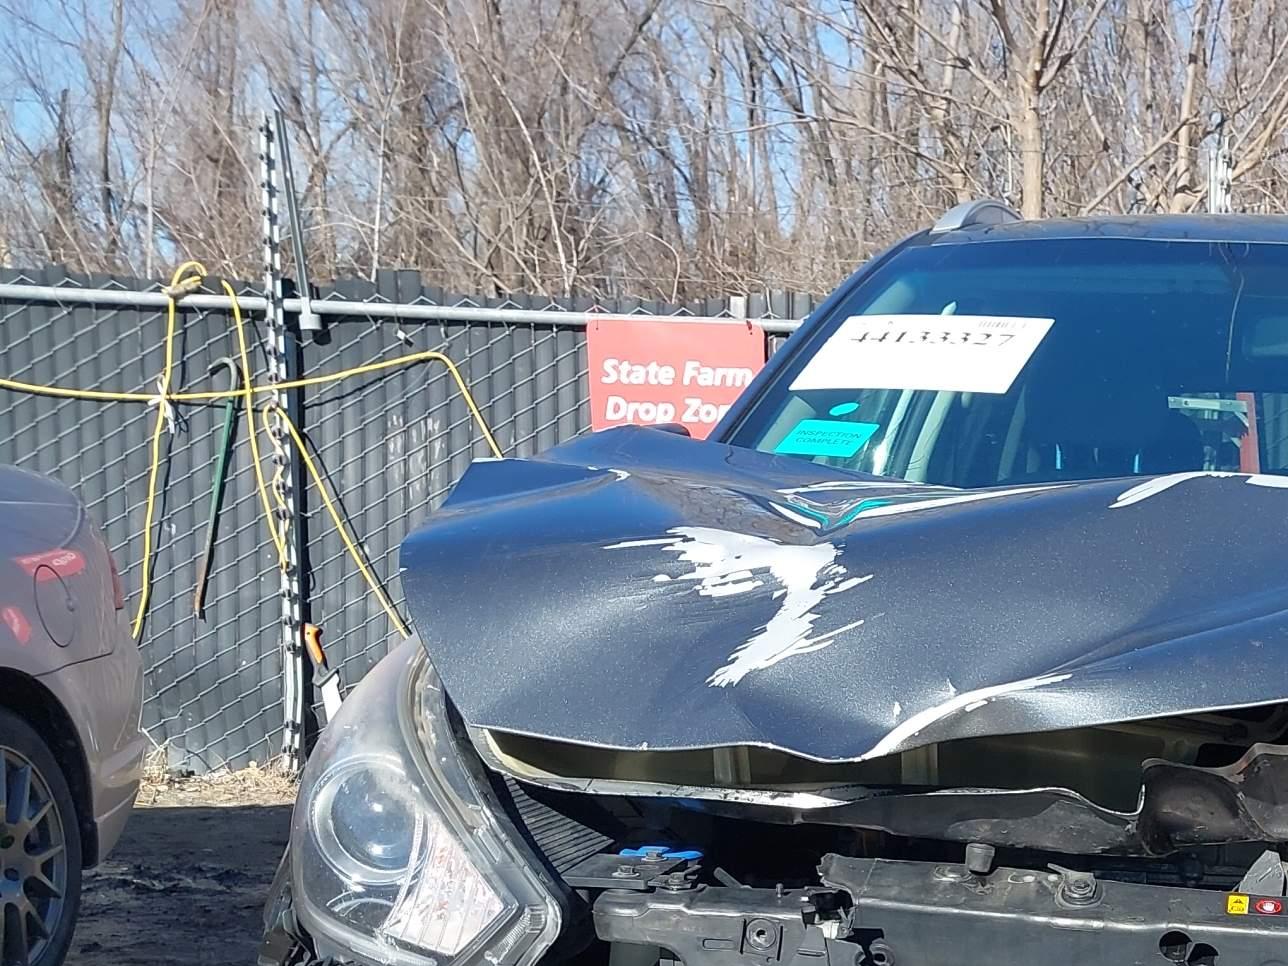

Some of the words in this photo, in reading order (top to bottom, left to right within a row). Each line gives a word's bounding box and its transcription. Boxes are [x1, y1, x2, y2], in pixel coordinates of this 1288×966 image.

[851, 331, 1016, 346] 44133327
[601, 358, 675, 385] State
[682, 360, 752, 386] Farm
[605, 395, 675, 424] Drop
[795, 429, 862, 439] INSPECTION
[795, 437, 853, 446] COMPLETE
